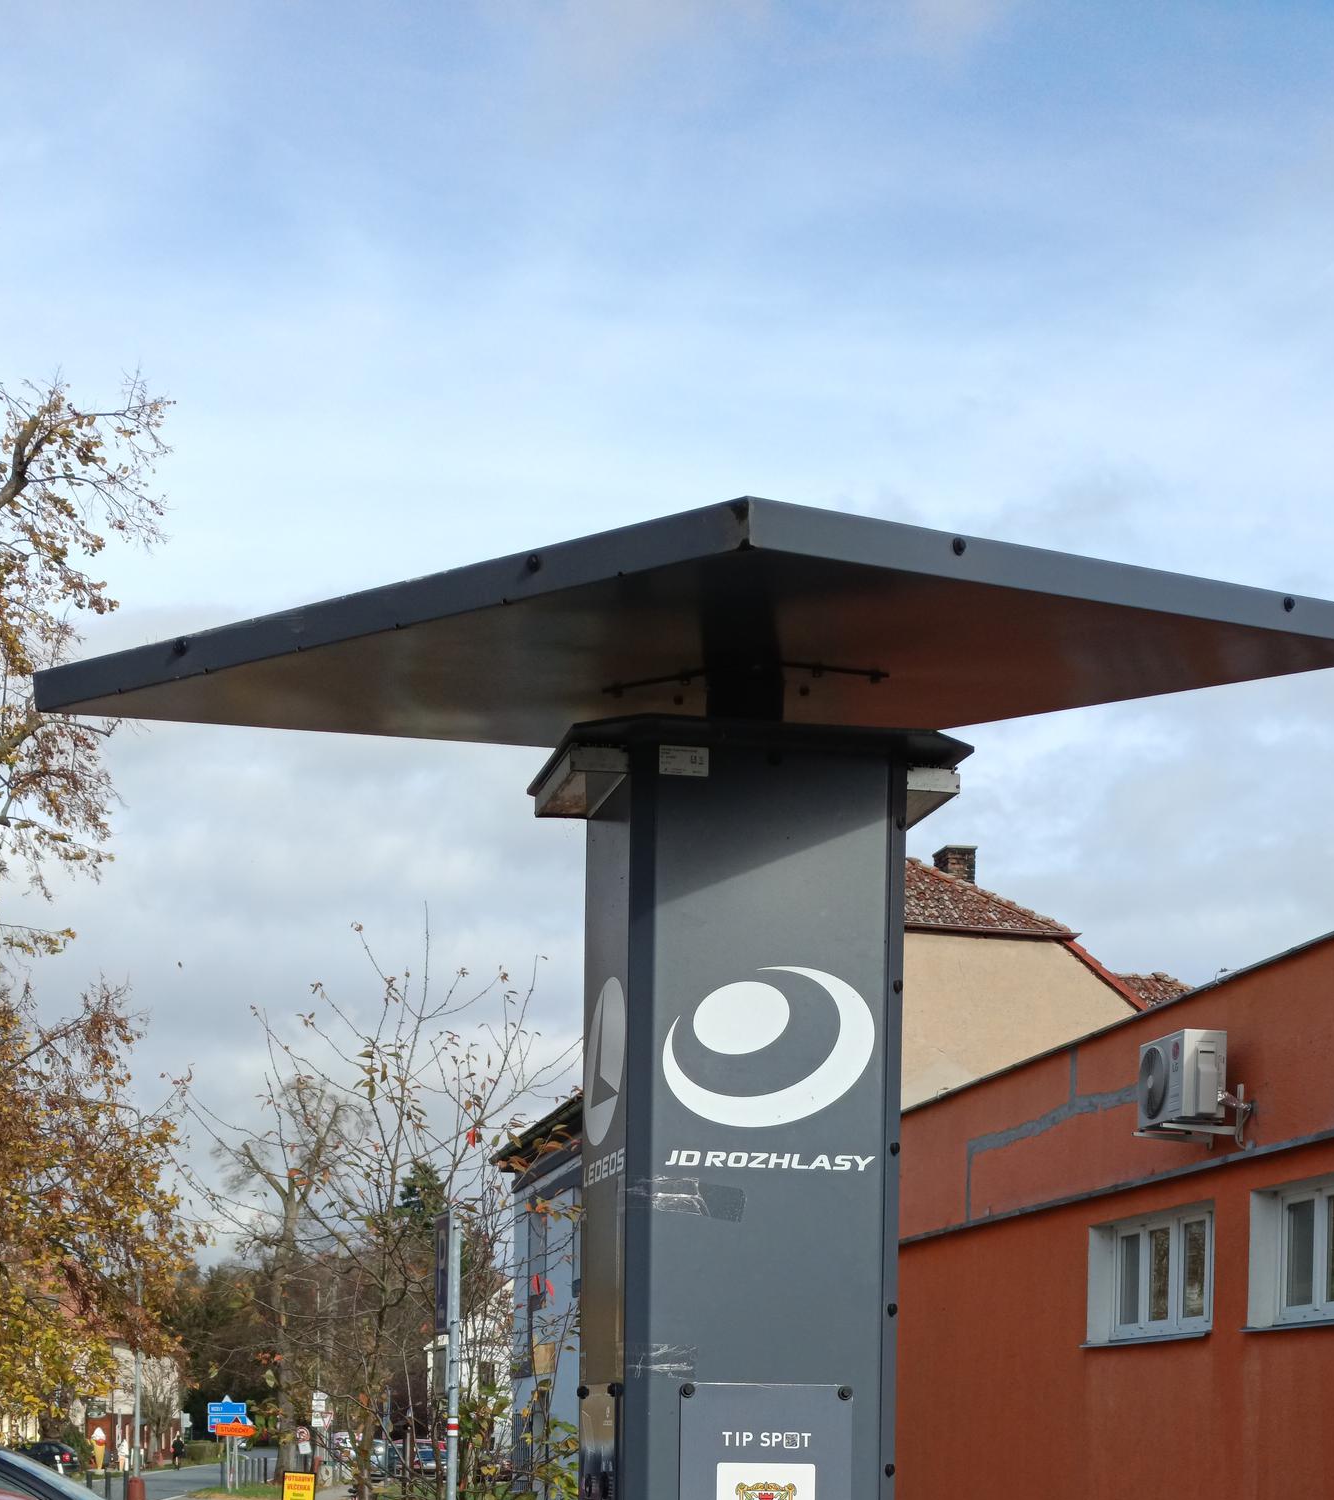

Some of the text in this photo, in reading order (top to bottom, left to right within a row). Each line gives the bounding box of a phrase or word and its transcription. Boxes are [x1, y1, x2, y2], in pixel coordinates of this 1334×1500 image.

[583, 1147, 626, 1188] LEDEOS
[665, 1150, 876, 1172] JD ROZHLASY
[722, 1431, 754, 1447] TIP
